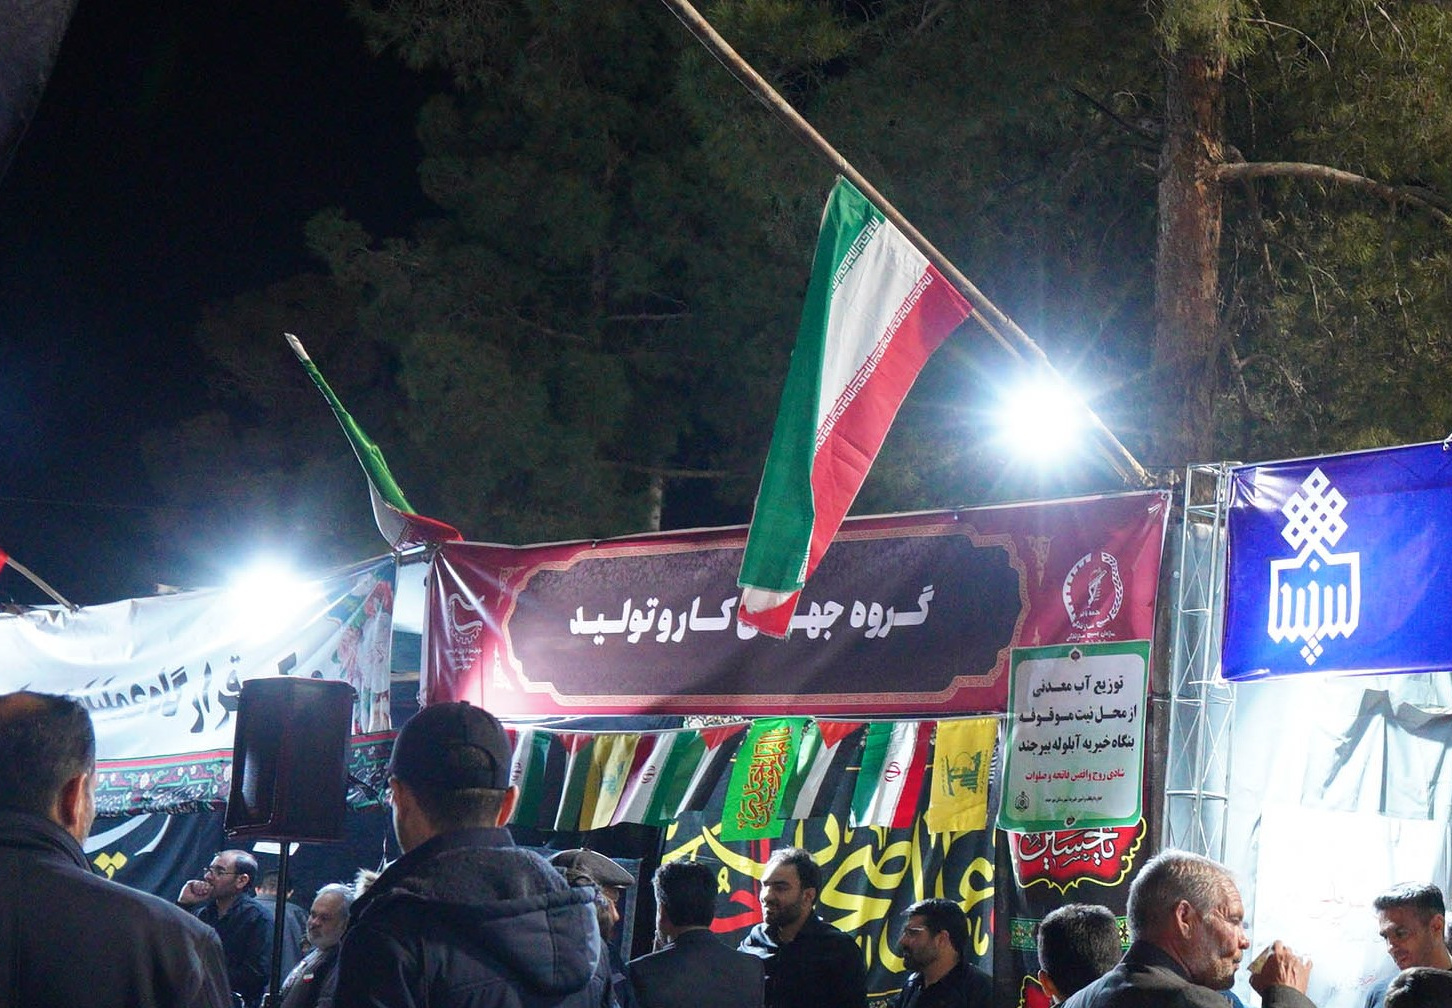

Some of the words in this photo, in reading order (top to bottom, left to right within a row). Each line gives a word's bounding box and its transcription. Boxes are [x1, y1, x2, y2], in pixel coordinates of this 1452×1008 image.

[569, 596, 660, 645] تولید
[671, 596, 738, 642] کار
[850, 584, 935, 638] گروه
[656, 612, 673, 643] و
[1032, 679, 1073, 698] معدنی
[1074, 675, 1092, 695] آب
[1093, 676, 1124, 695] توزیع
[1018, 707, 1074, 727] موقوفه
[1095, 705, 1127, 724] محل
[1128, 705, 1137, 723] از
[1018, 739, 1052, 757] بیرجند
[1082, 735, 1111, 754] خیریه
[1112, 734, 1135, 752] بنگاه
